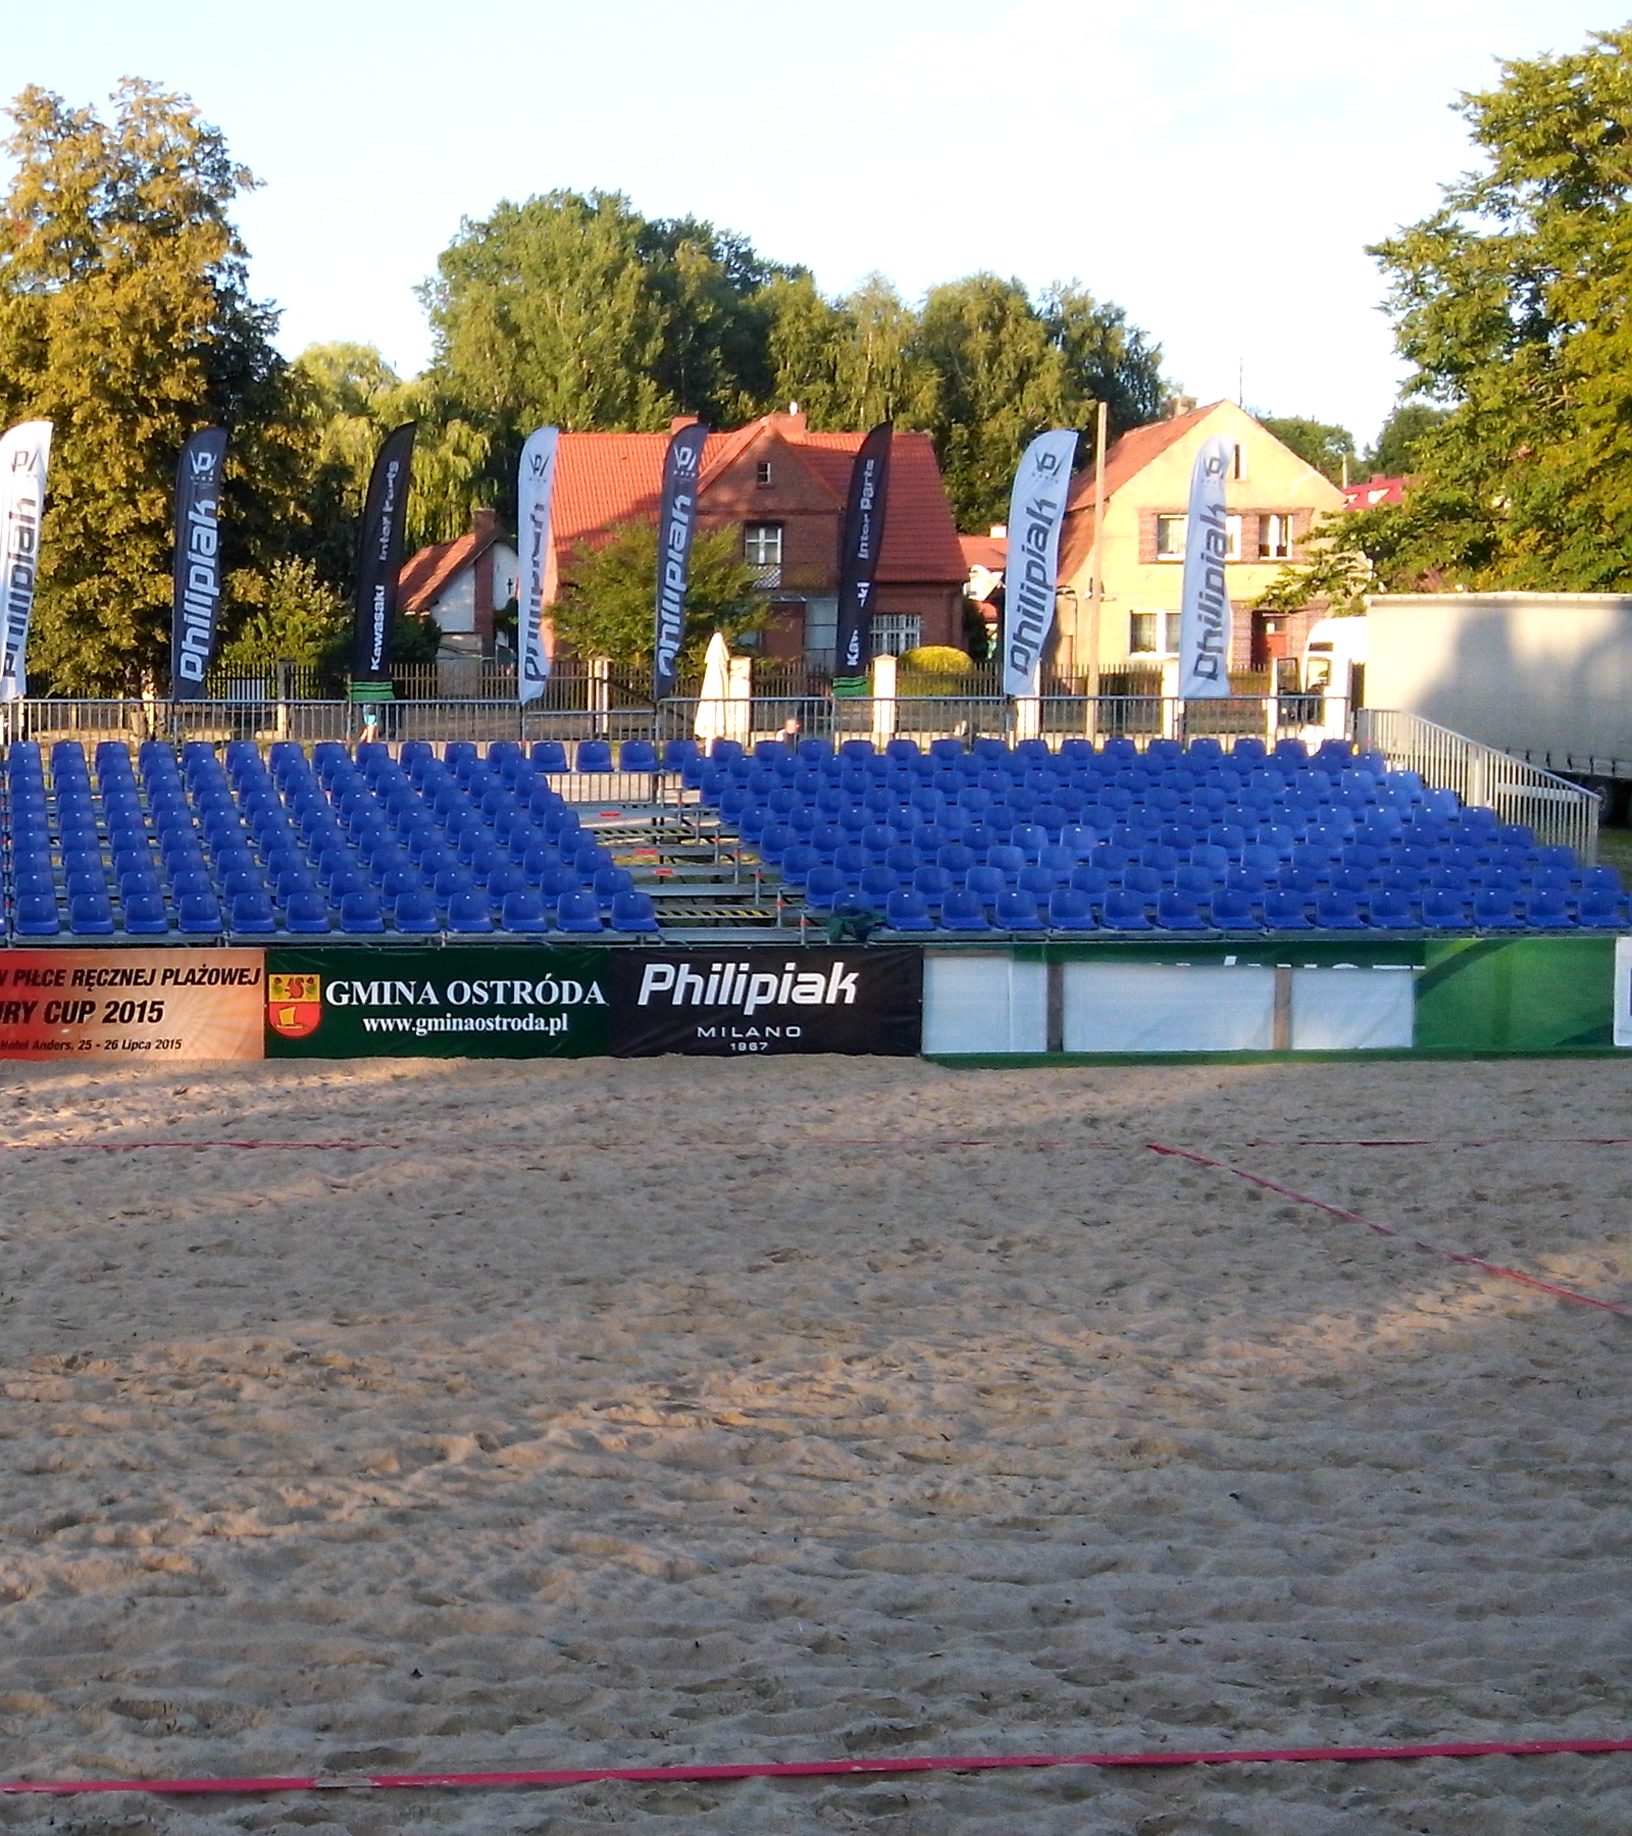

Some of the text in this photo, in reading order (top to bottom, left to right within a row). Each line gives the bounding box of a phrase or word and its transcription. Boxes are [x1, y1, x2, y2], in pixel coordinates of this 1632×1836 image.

[860, 459, 874, 510] Parts
[179, 500, 221, 682] Philipiak
[370, 585, 385, 671] Kawasaki
[379, 516, 393, 561] Inter
[1010, 498, 1058, 676] Philipiak
[13, 968, 68, 987] PIŁCE
[71, 967, 157, 992] RĘCZNEJ
[160, 963, 262, 986] PLAŻOWEJ
[325, 972, 607, 1006] GMINA OSTRÓDA
[636, 961, 860, 1016] Philipiak
[44, 1000, 97, 1024] CUP
[101, 1000, 165, 1024] 2015
[362, 1013, 569, 1037] www.gminaostroda.pl
[0, 1039, 30, 1051] Hotel
[77, 1040, 92, 1051] 25
[104, 1039, 119, 1051] 26
[122, 1039, 151, 1052] Lipca
[155, 1038, 183, 1050] 2015
[696, 1026, 802, 1038] MILANO
[730, 1041, 769, 1052] 1967
